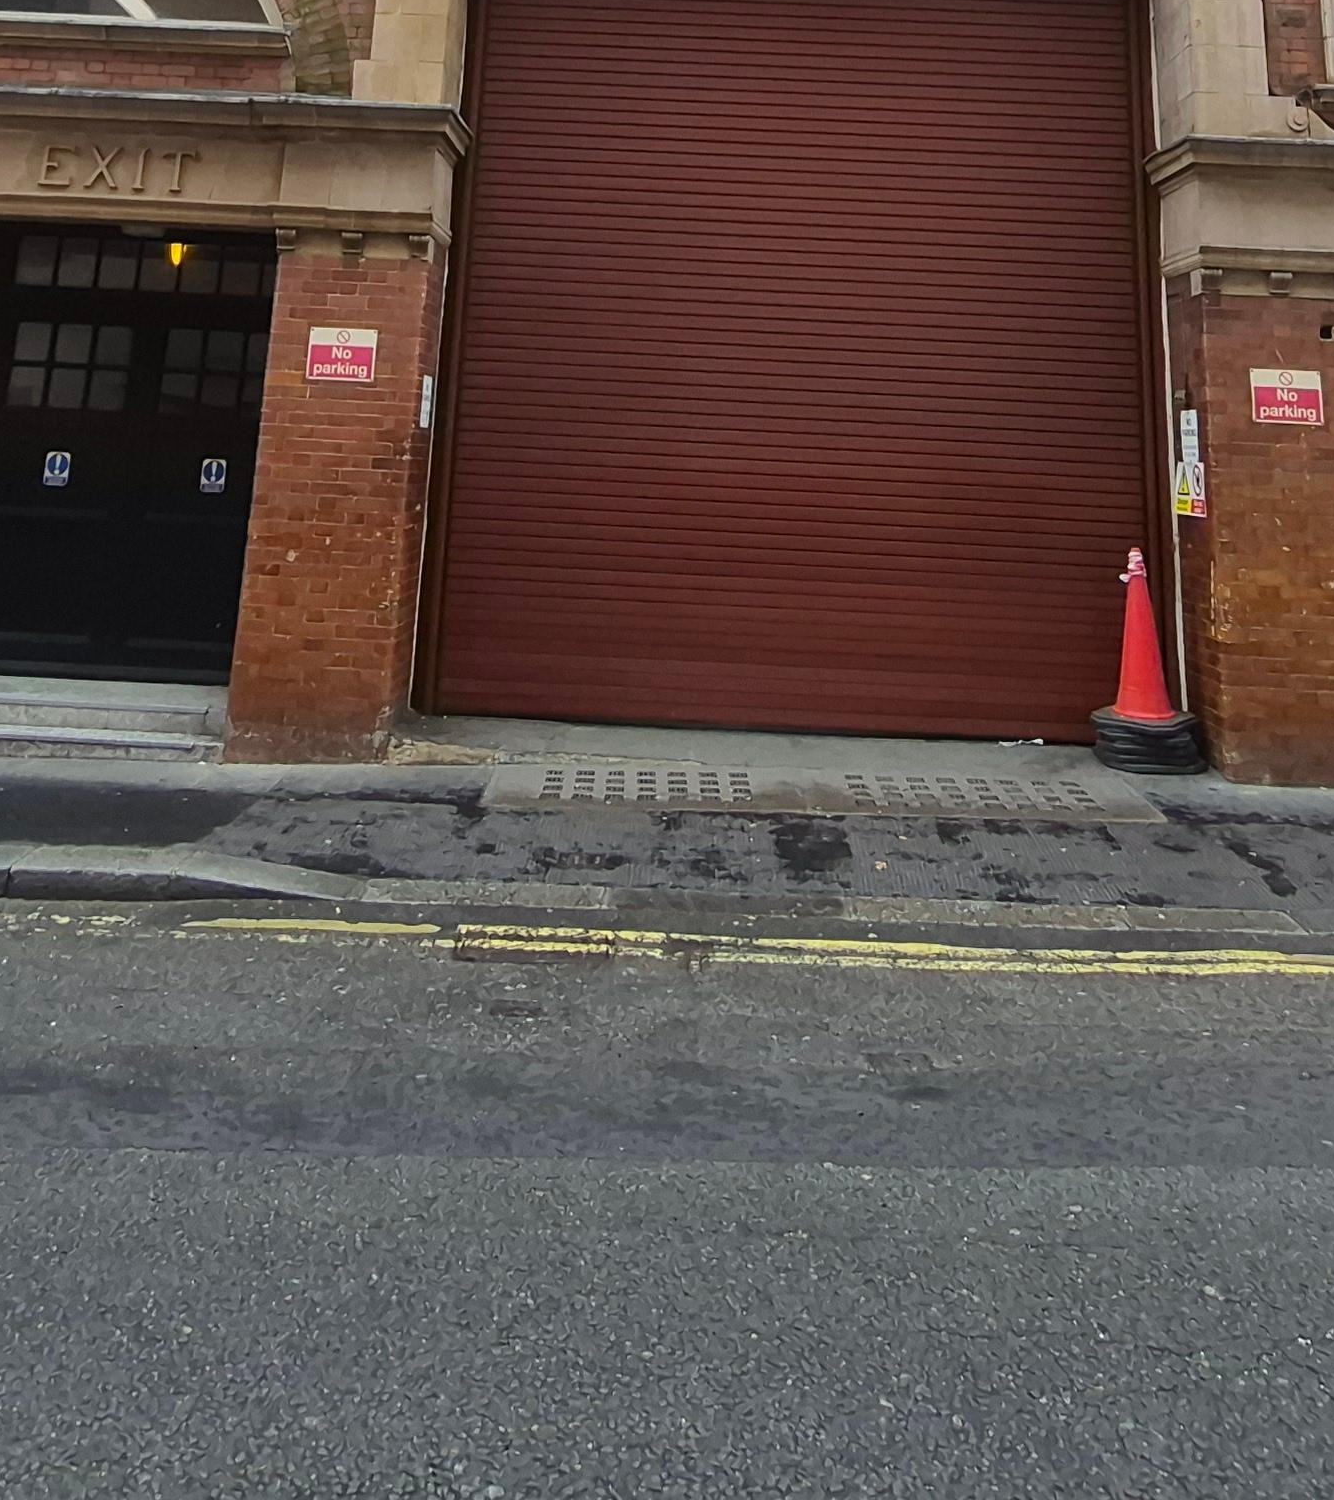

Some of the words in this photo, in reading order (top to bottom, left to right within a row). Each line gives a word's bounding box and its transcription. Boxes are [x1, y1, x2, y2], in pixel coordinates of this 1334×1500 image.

[37, 145, 200, 193] EXIT
[330, 346, 352, 360] No
[313, 362, 368, 378] parking
[1276, 388, 1298, 402] No
[1260, 404, 1317, 422] parking
